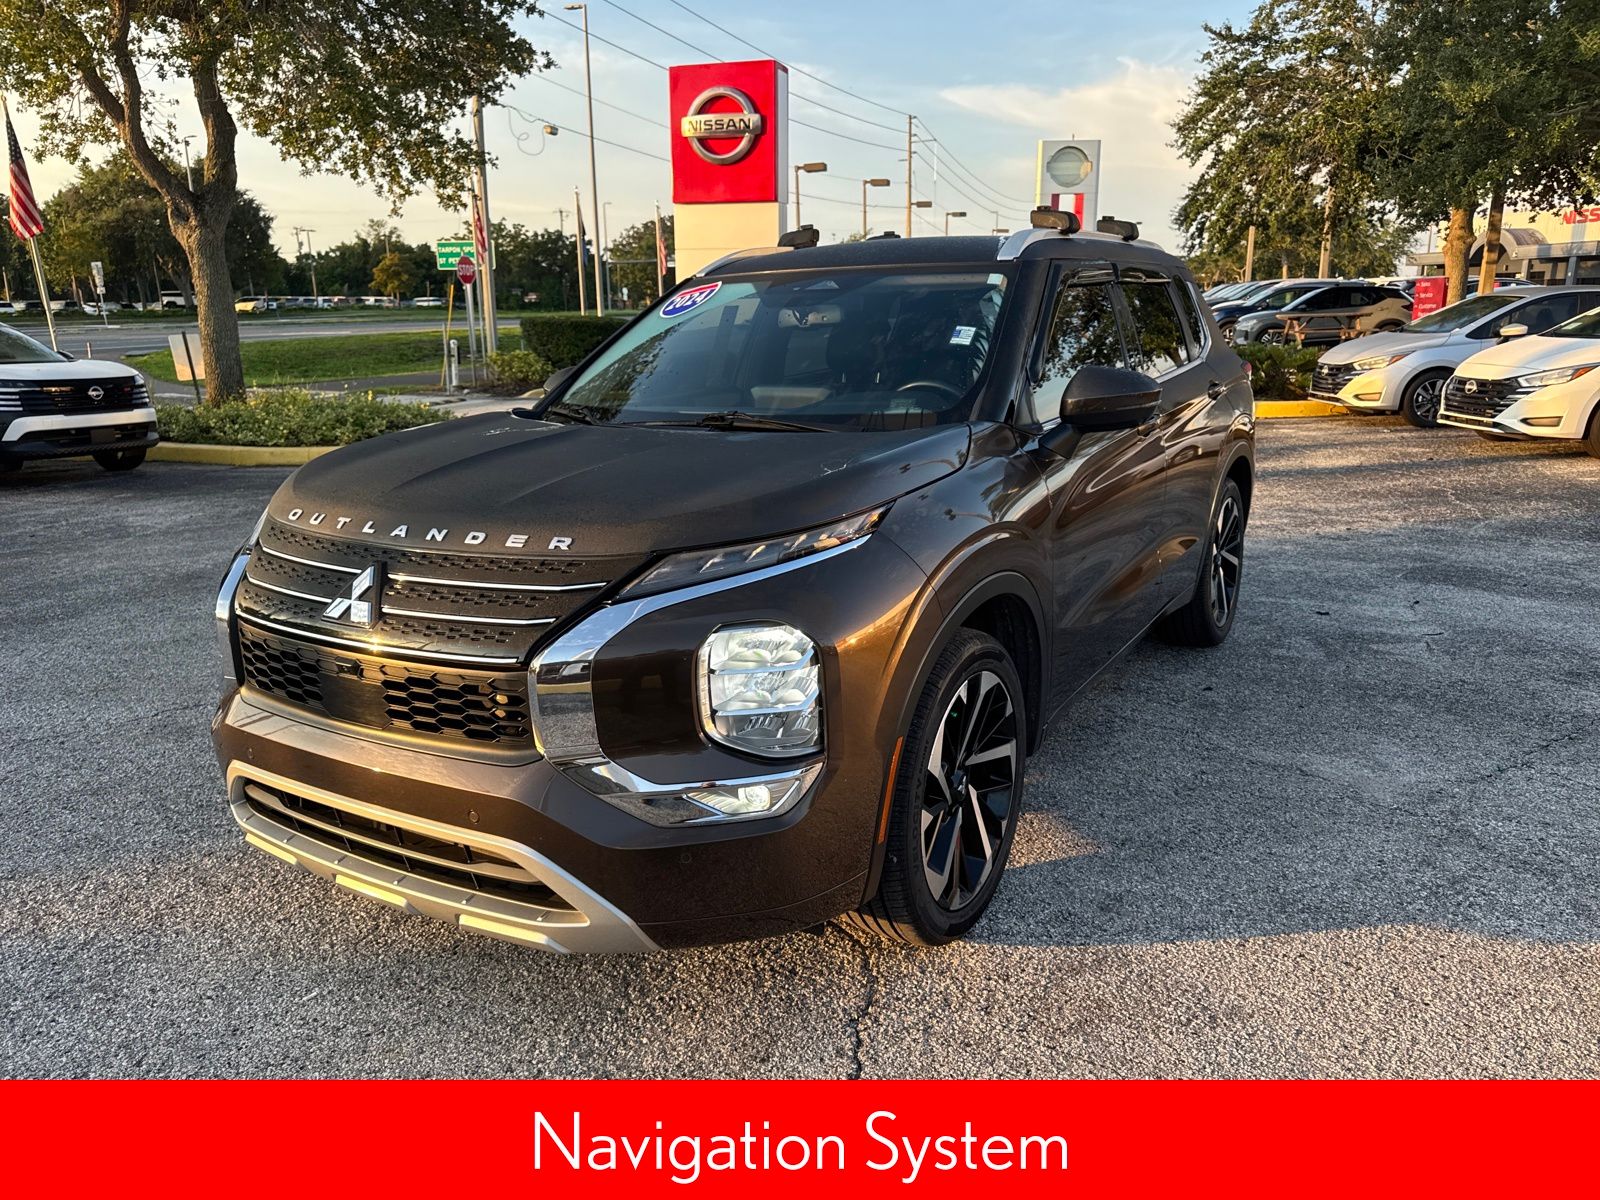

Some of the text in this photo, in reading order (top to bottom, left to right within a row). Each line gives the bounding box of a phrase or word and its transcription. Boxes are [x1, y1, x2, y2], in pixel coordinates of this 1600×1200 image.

[687, 117, 752, 132] NISSAN
[458, 264, 475, 276] STOP
[665, 290, 709, 312] 2024
[287, 508, 573, 551] OUTLANDER
